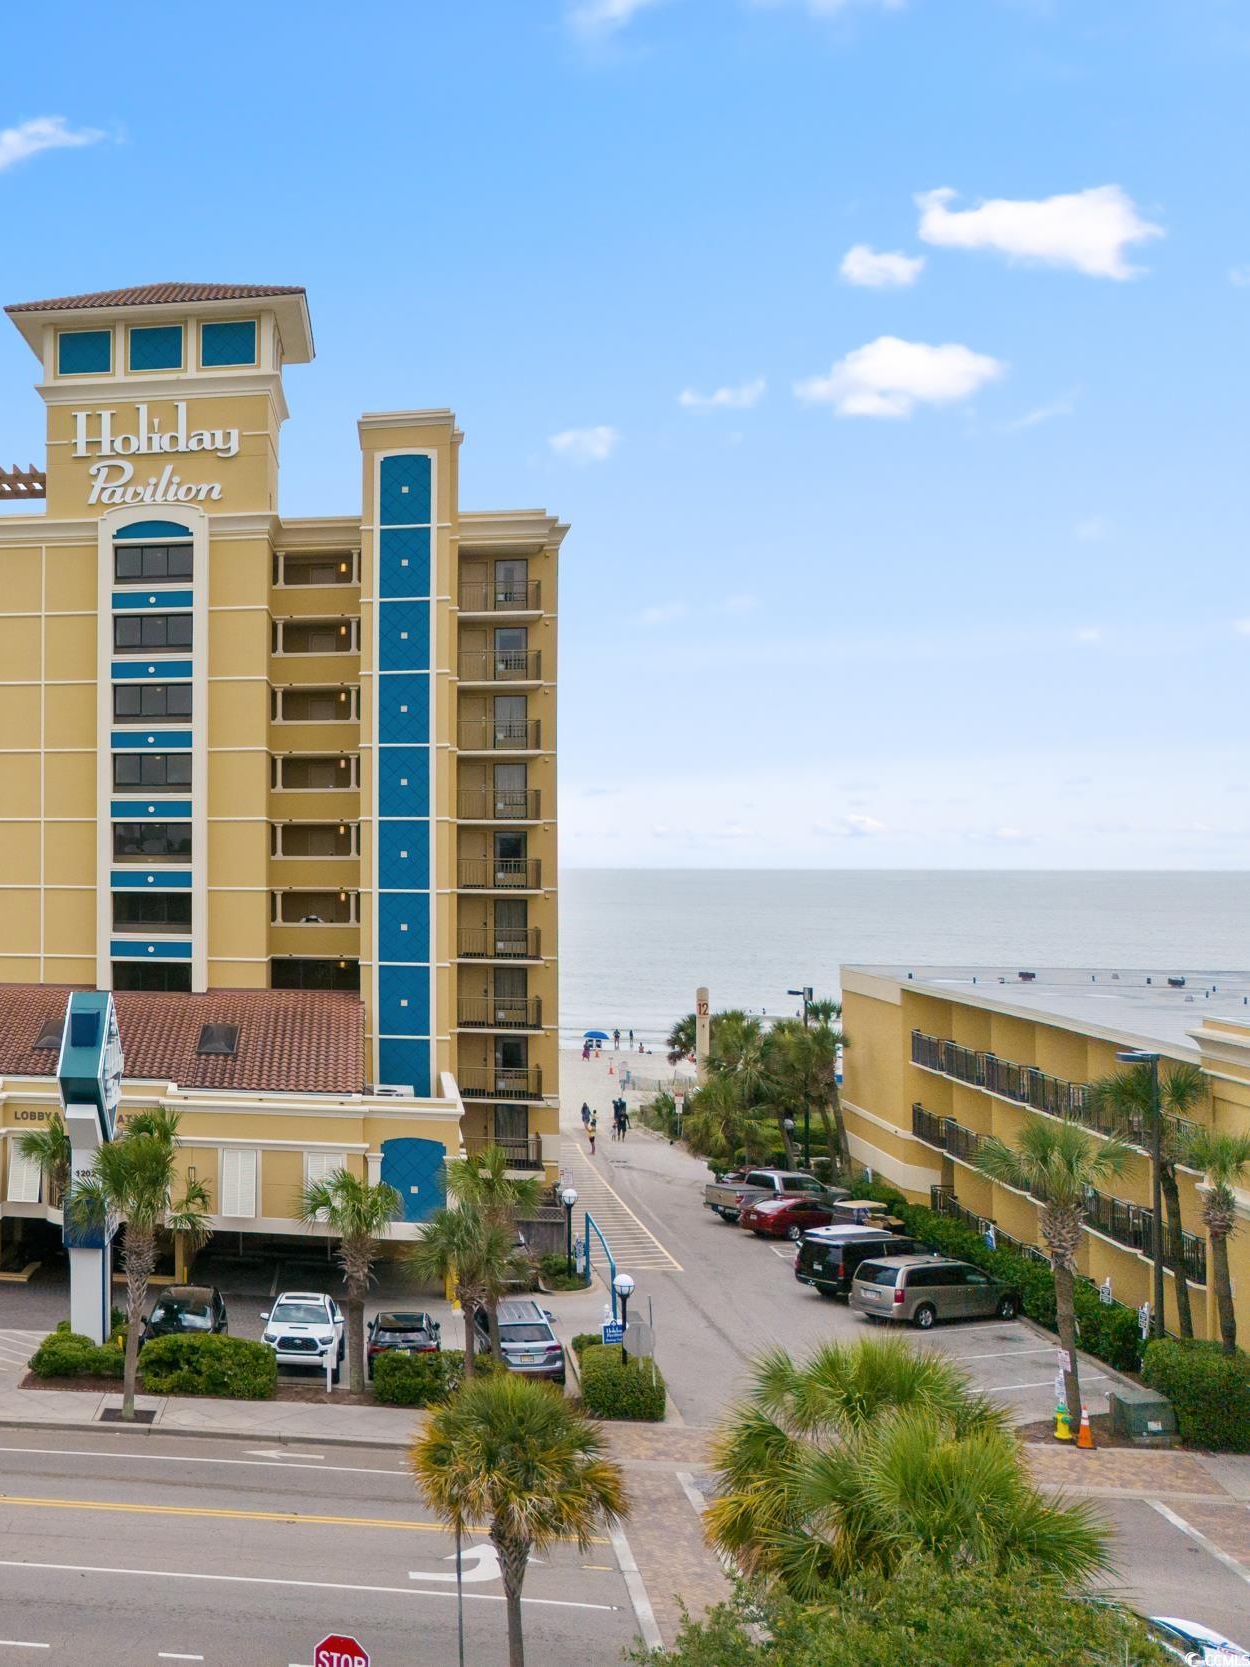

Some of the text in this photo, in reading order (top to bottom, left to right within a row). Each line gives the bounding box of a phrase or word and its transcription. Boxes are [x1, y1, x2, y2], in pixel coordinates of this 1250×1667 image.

[71, 401, 239, 458] Holiday
[87, 459, 223, 505] Pavilion
[697, 1002, 709, 1016] 12
[14, 1110, 52, 1121] LOBBY
[318, 1650, 366, 1667] STOP
